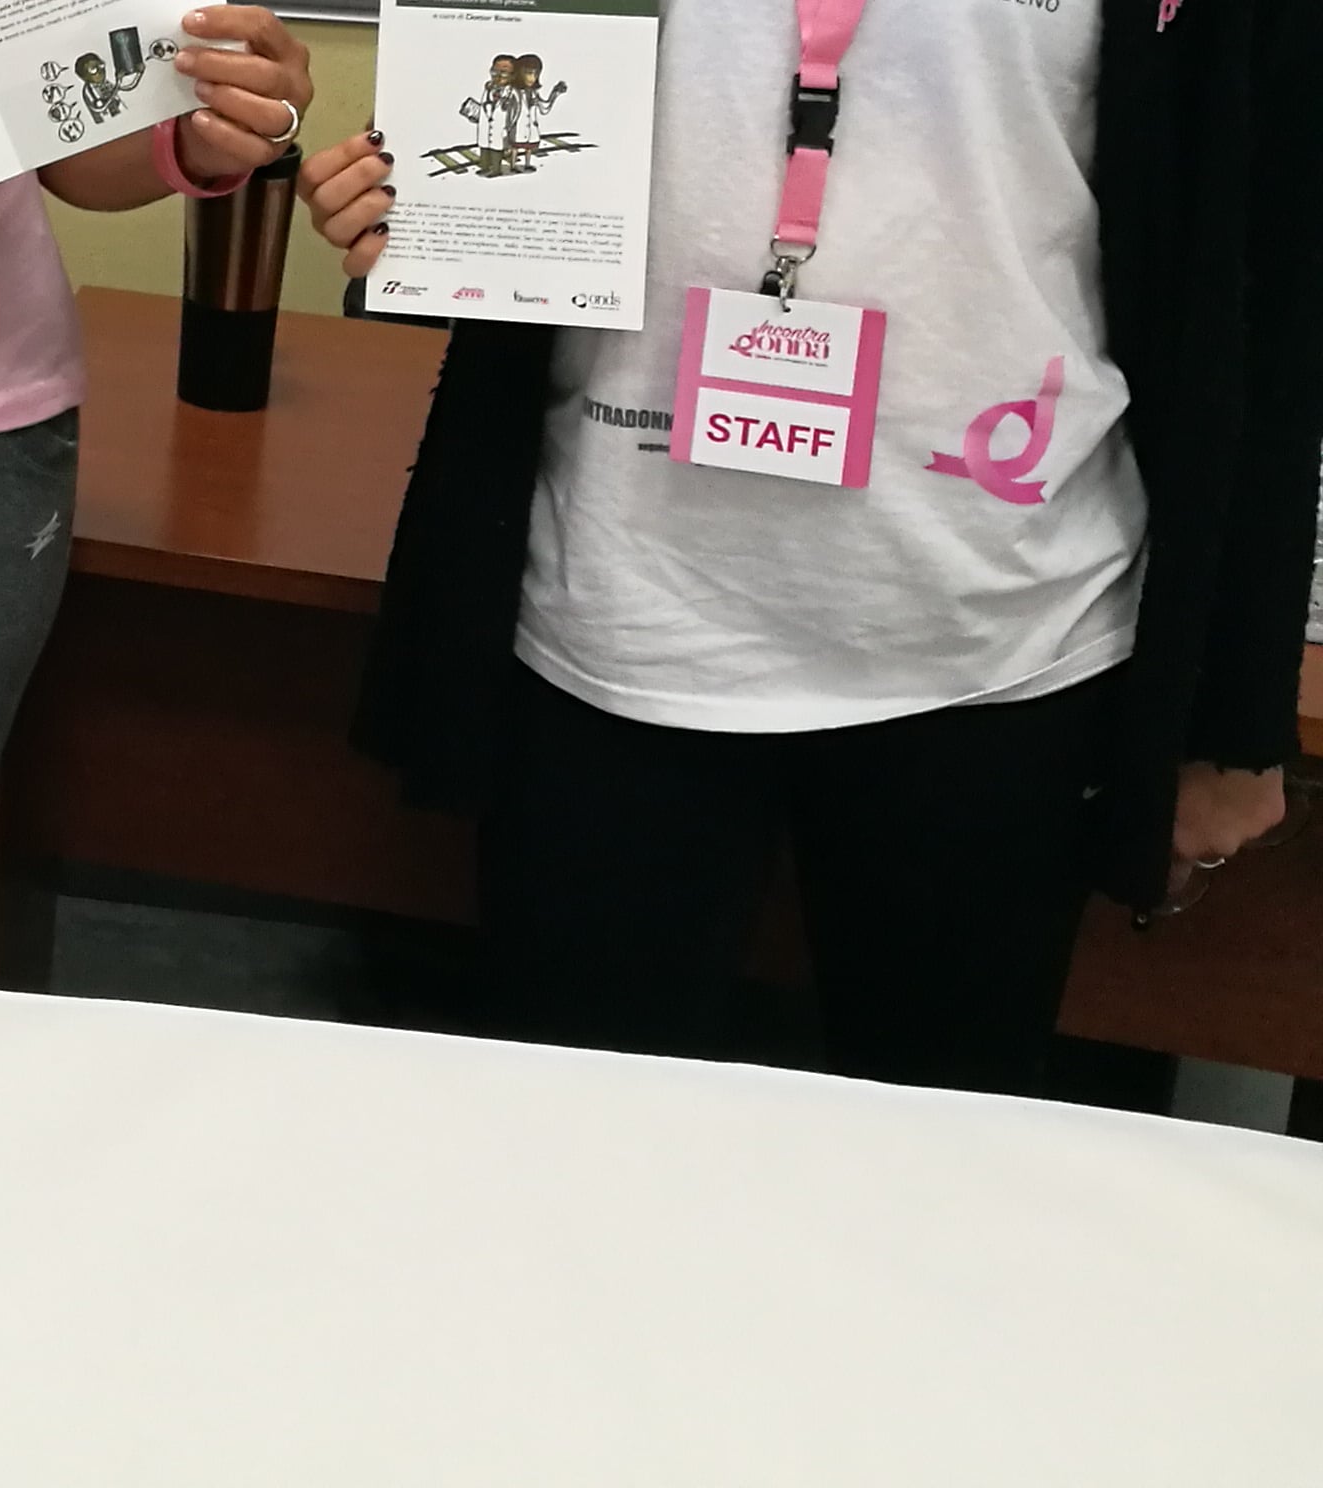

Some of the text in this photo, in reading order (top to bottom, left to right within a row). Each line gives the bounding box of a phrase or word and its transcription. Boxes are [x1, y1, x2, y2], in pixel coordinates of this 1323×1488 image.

[589, 291, 621, 305] onds
[757, 320, 830, 343] Incontra
[583, 397, 674, 431] NTRADONN
[706, 413, 835, 457] STAFF
